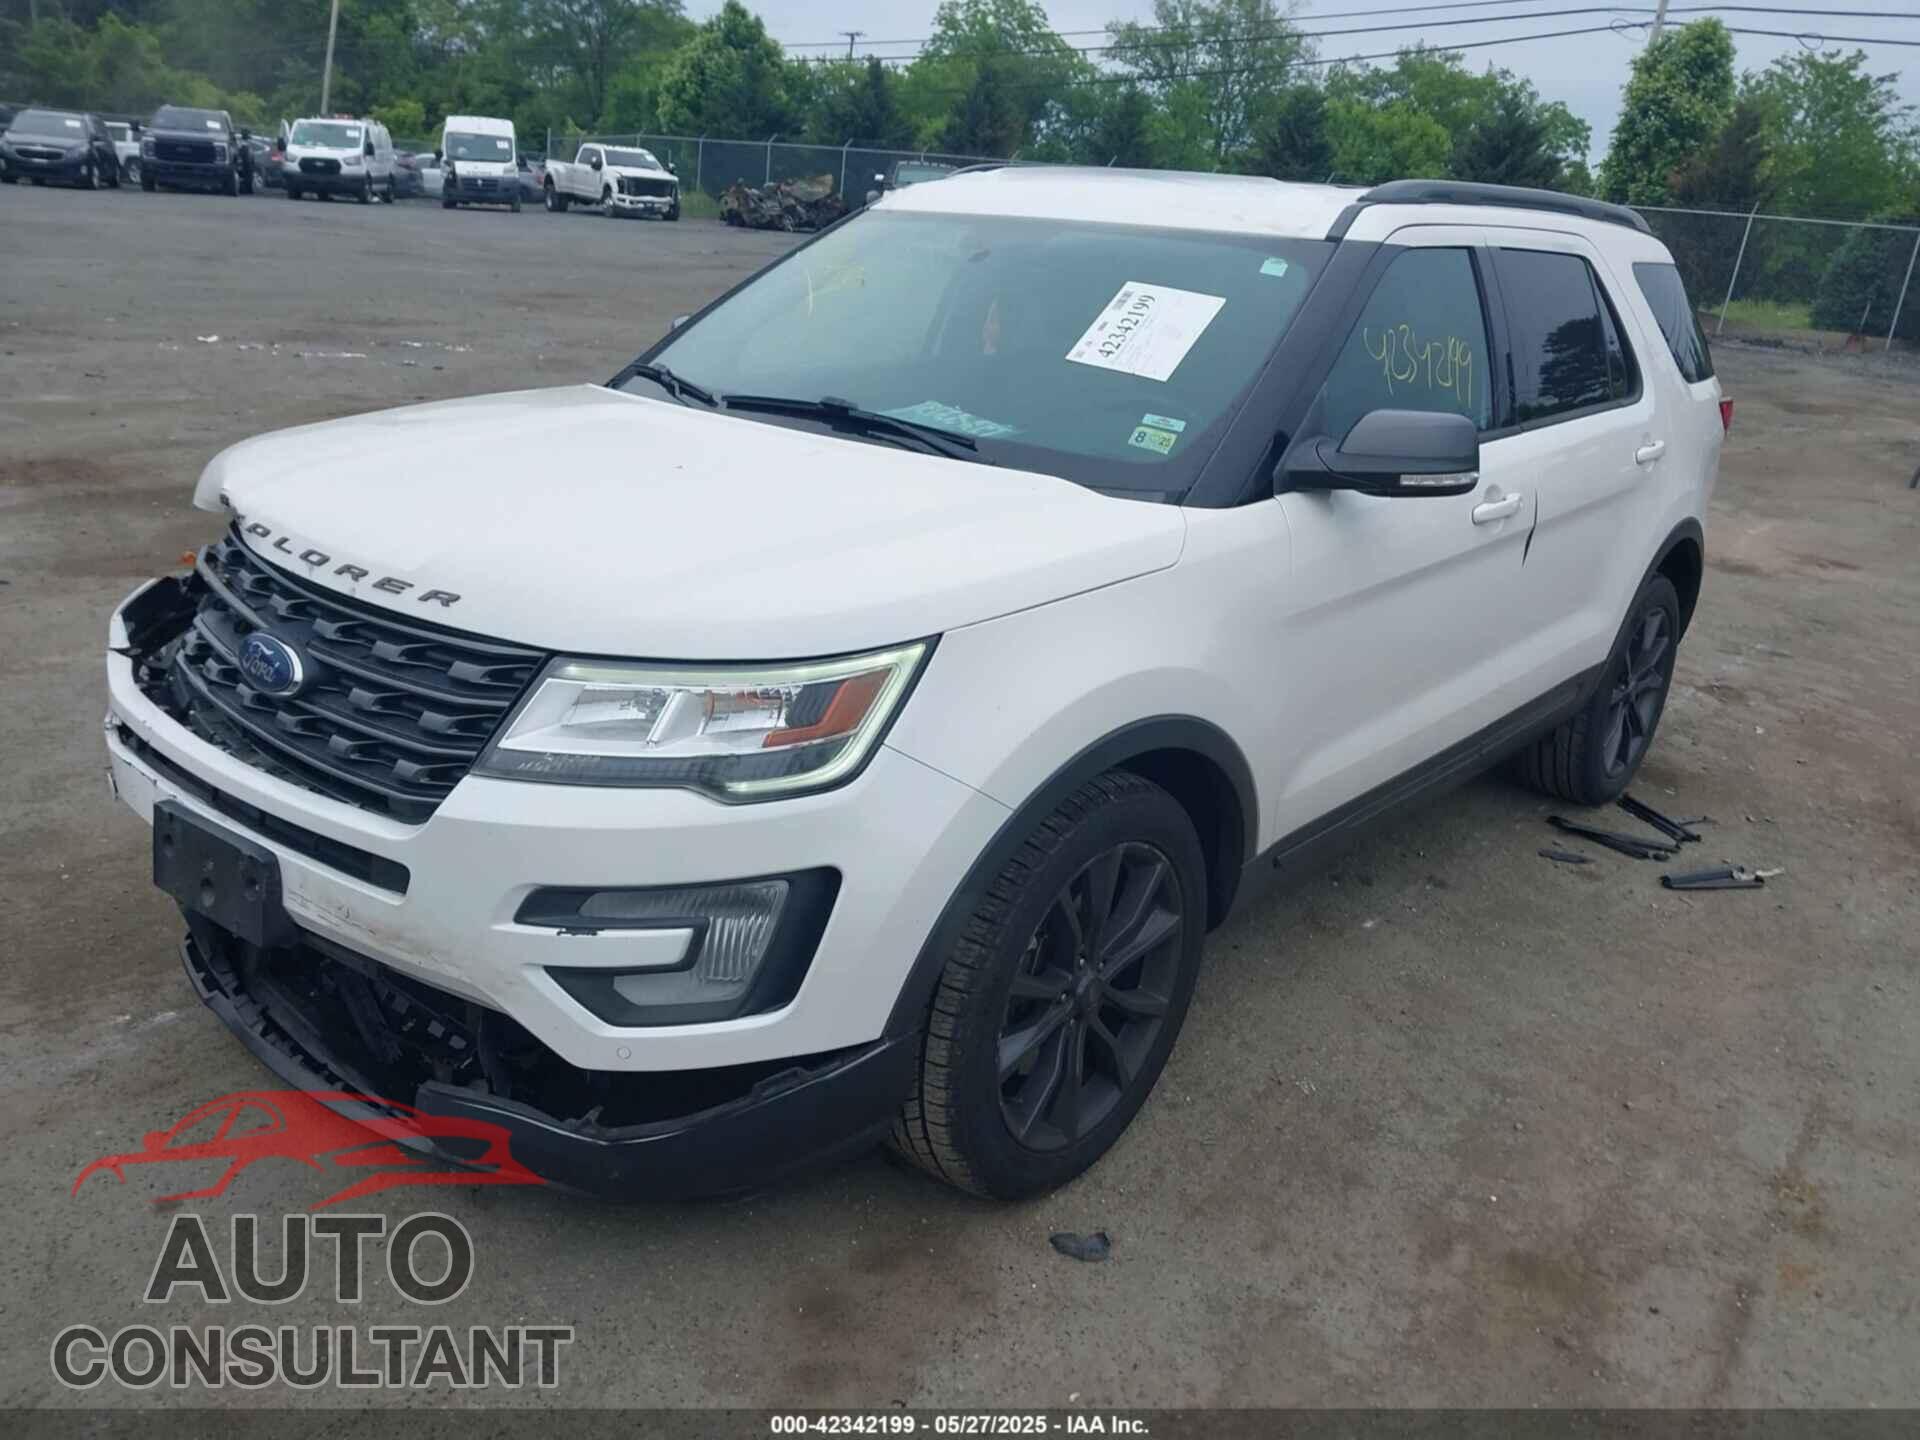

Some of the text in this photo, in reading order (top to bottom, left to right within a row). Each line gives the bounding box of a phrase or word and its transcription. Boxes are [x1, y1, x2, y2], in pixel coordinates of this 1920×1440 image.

[1098, 294, 1156, 358] 42342199
[1135, 431, 1146, 443] 8
[241, 640, 281, 682] Ford
